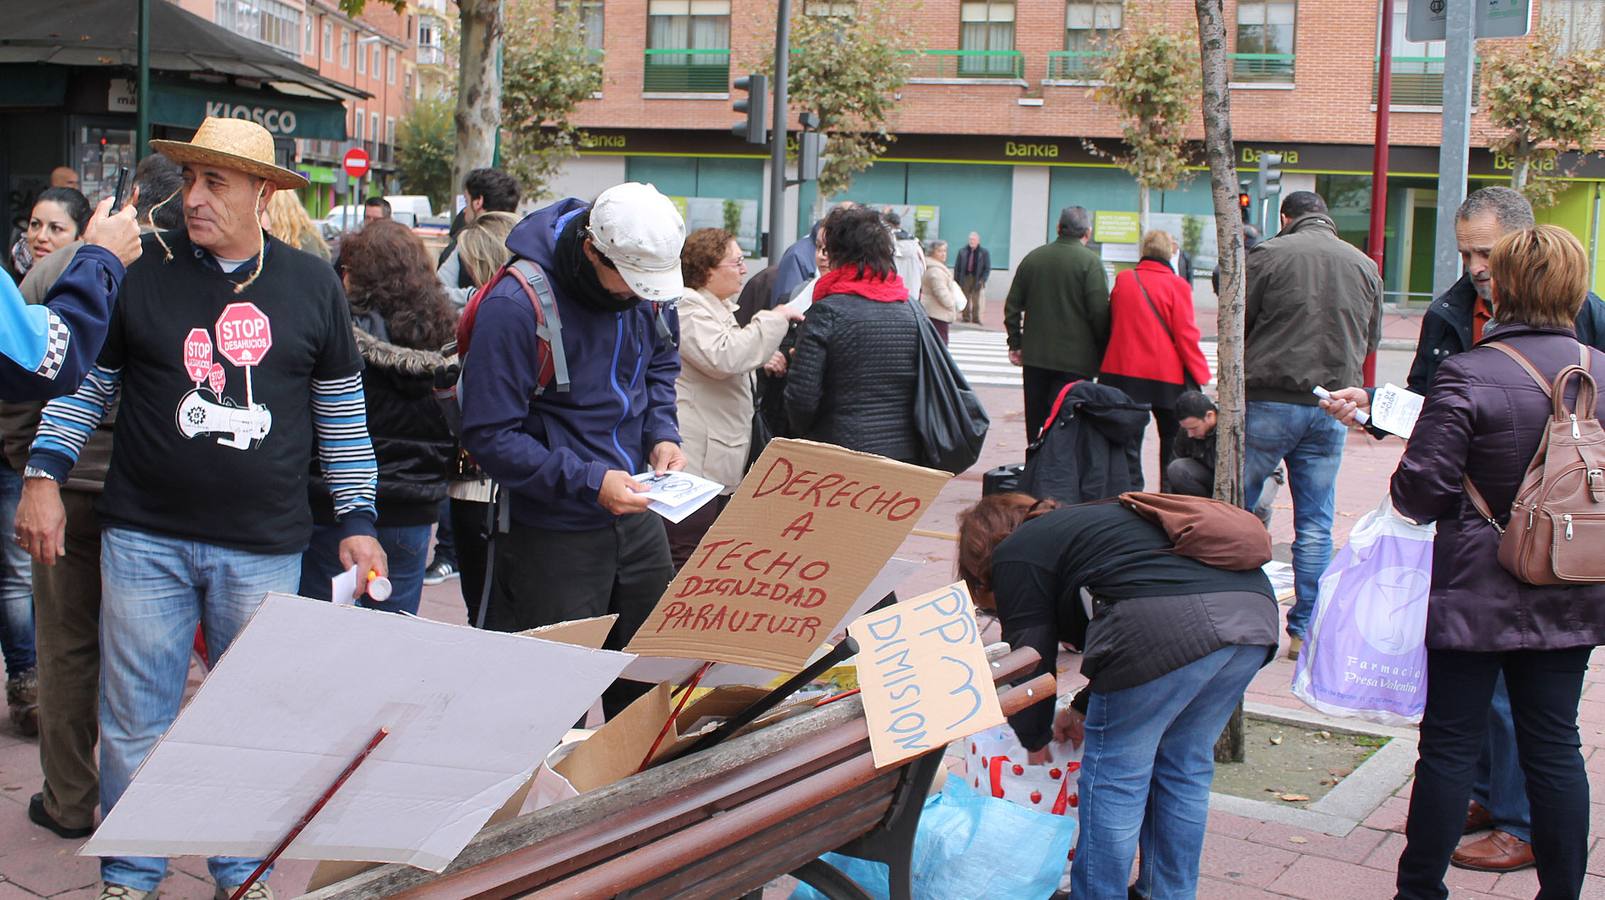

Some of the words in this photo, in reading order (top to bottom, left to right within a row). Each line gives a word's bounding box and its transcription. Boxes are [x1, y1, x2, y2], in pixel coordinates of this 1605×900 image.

[1005, 141, 1058, 157] Bankia
[222, 319, 265, 340] STOP
[188, 341, 211, 359] STOP
[224, 339, 267, 351] DESAHUCIOS
[752, 456, 921, 522] DERECHO
[781, 511, 815, 541] A
[697, 538, 830, 580] TECHO
[673, 575, 828, 609] DIGNIDAD
[1343, 671, 1378, 688] Presa
